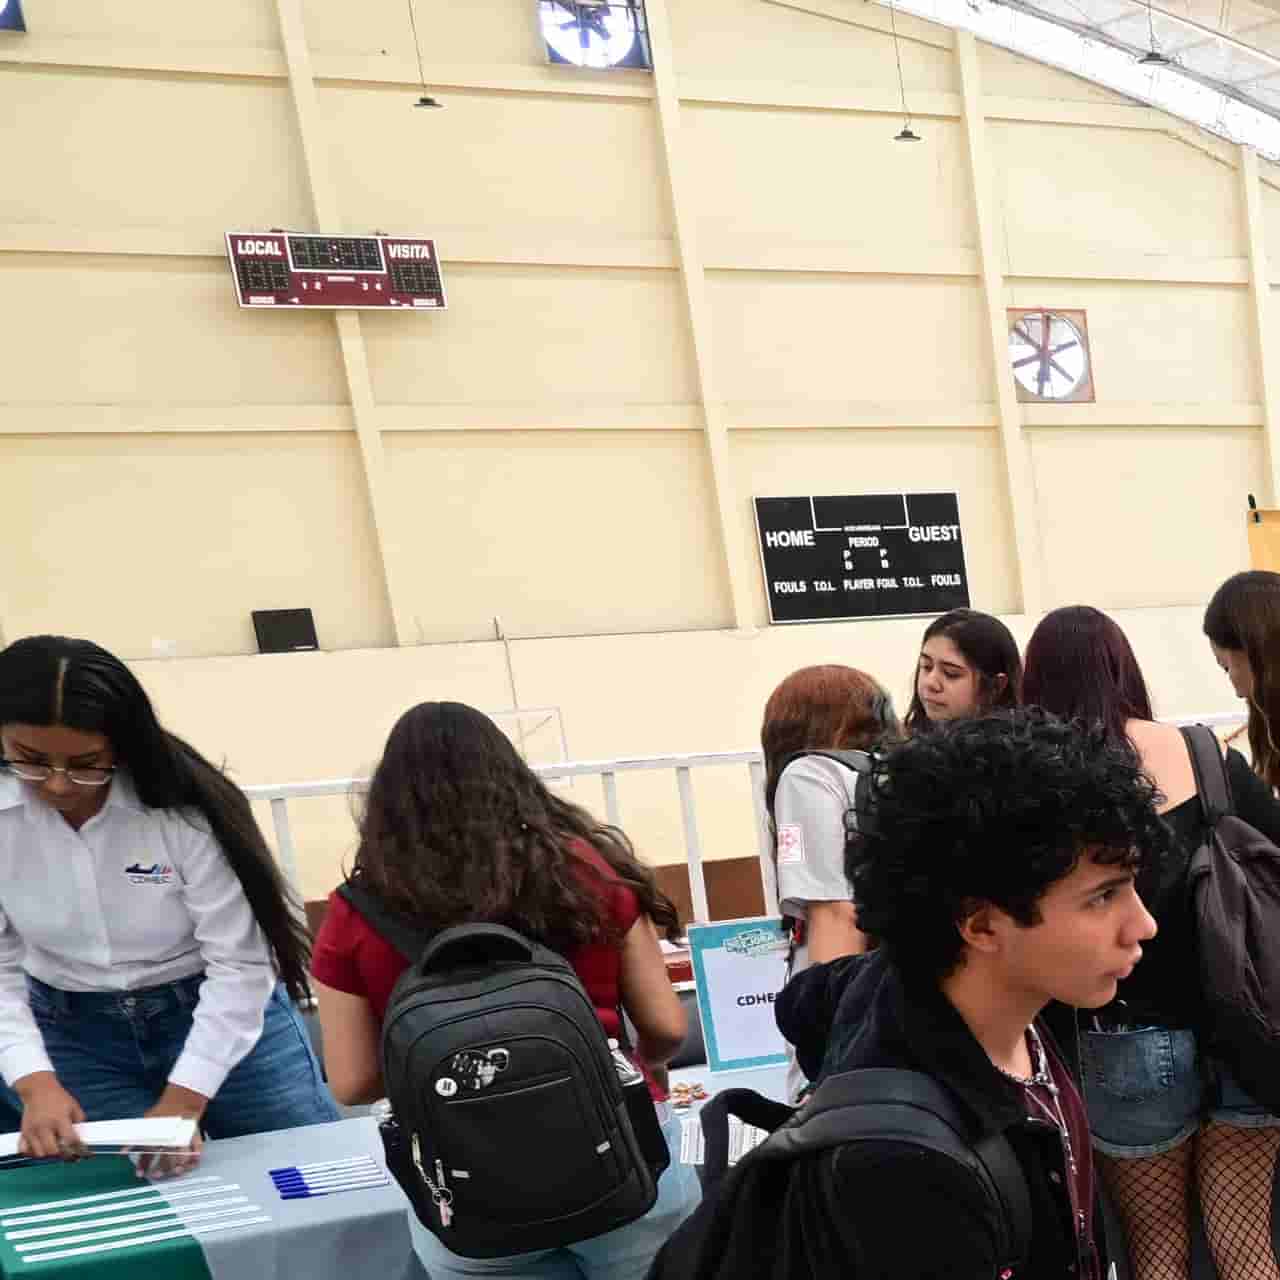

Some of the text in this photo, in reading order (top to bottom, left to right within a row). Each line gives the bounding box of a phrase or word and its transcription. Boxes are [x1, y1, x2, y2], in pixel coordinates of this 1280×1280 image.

[237, 238, 282, 256] LOCAL
[387, 243, 430, 259] VISITA
[766, 530, 816, 547] HOME
[848, 536, 879, 548] PERIOD
[908, 525, 959, 542] GUEST
[774, 580, 807, 594] FOULS
[843, 578, 875, 590] PLAYER
[876, 578, 899, 589] FOUL
[931, 573, 961, 586] FOULS
[736, 992, 777, 1007] CDHE
